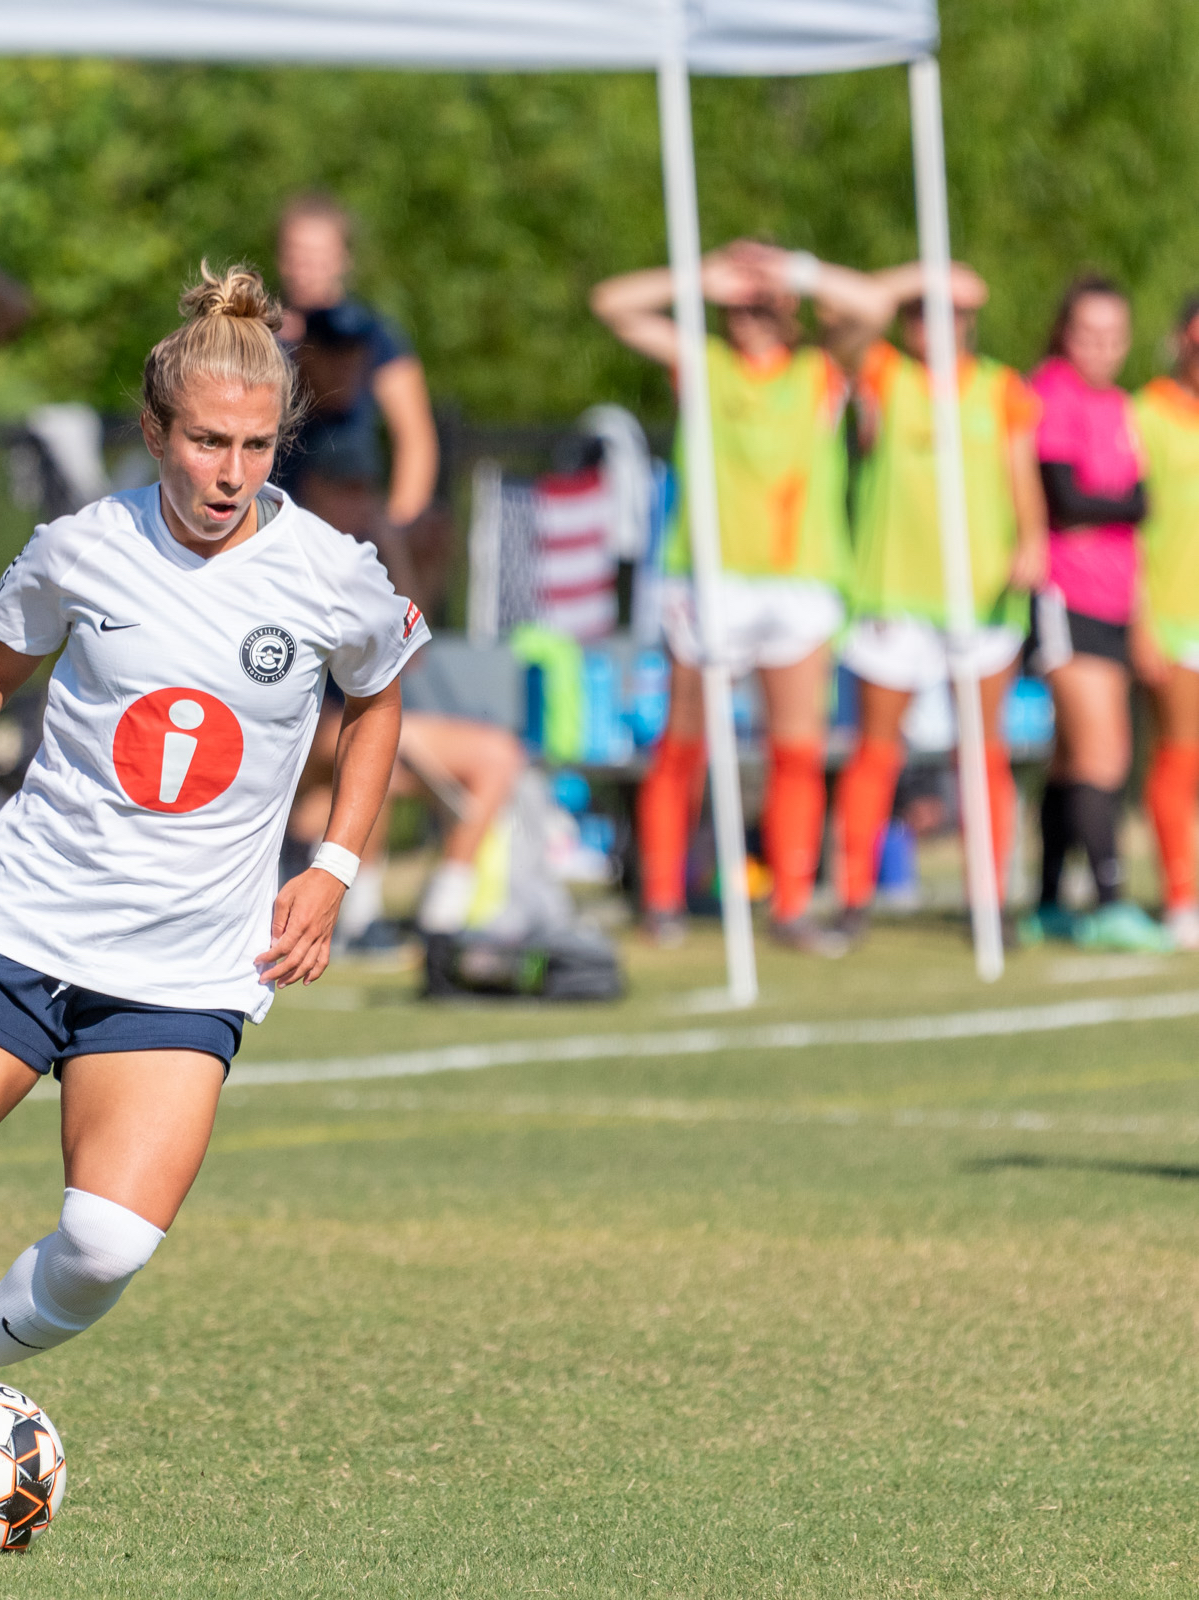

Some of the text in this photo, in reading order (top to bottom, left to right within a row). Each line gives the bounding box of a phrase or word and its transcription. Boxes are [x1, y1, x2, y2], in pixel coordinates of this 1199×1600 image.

[244, 628, 294, 654] ASHEVILLE CITY
[247, 666, 286, 682] SOCCER CLUB
